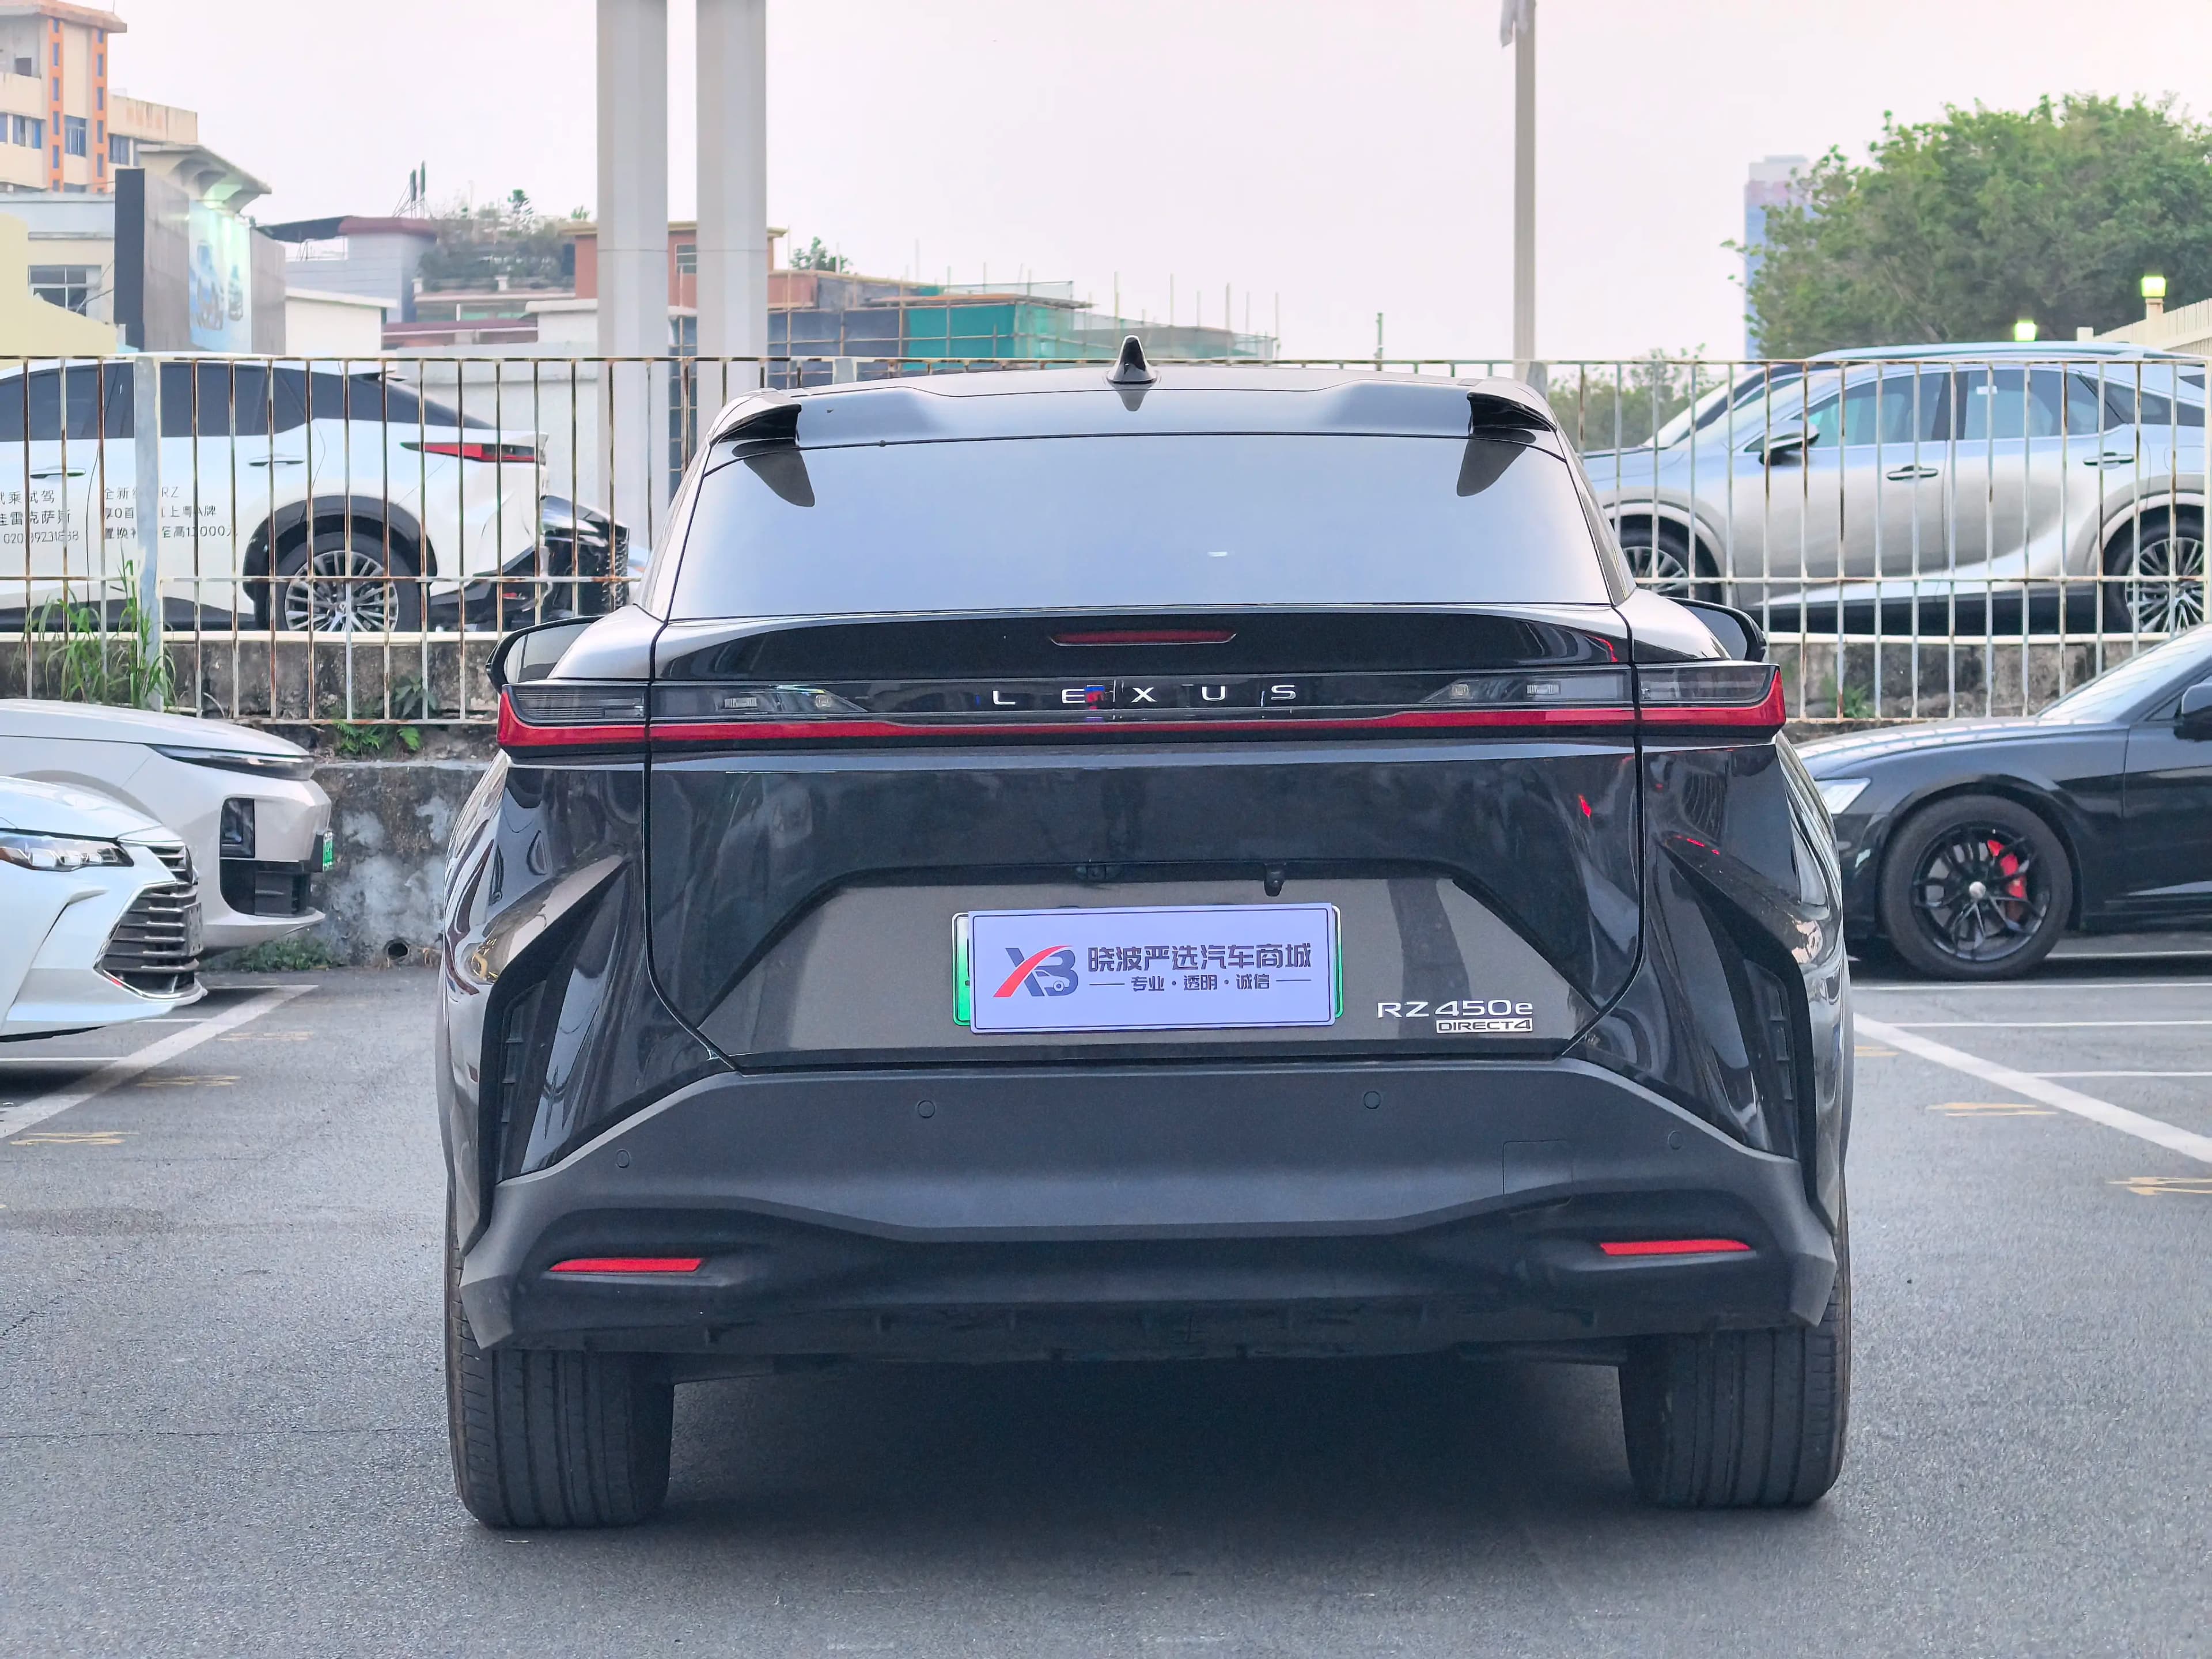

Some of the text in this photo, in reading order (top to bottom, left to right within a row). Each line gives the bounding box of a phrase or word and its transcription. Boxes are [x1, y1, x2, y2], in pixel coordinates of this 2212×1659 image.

[993, 684, 1296, 705] LEXUS
[1088, 942, 1312, 972] 晓波严选汽车商城
[1377, 999, 1533, 1018] RZ 450e
